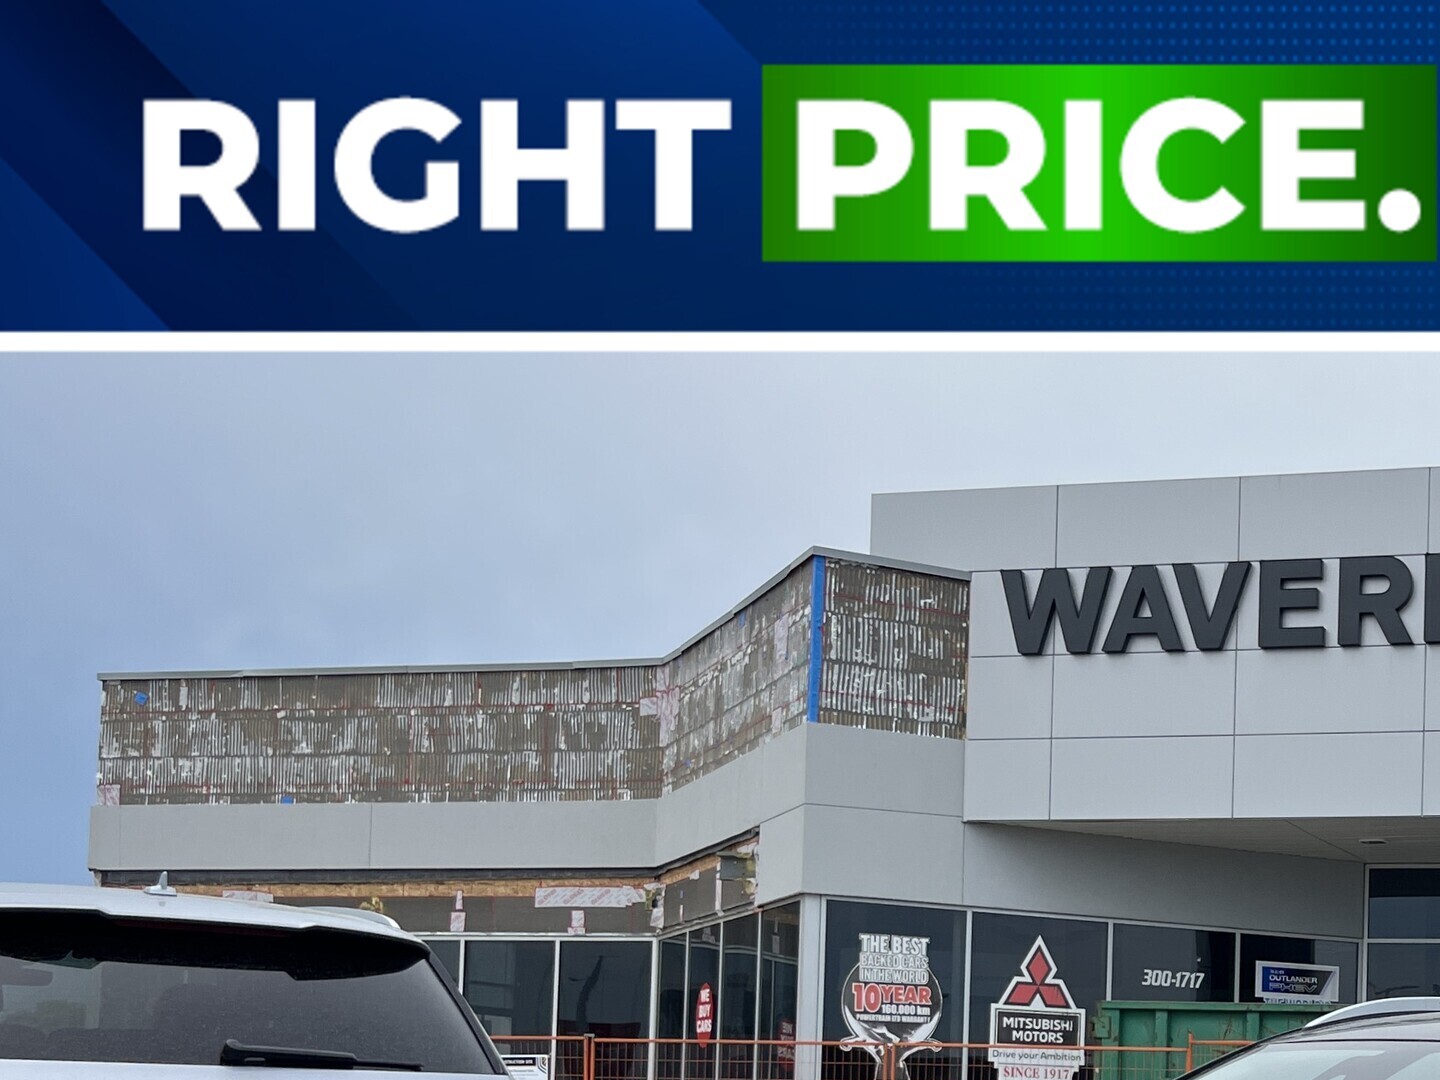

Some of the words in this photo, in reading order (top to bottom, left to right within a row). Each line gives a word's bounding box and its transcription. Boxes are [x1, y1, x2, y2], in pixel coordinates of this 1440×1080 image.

[860, 934, 889, 954] THE
[891, 935, 929, 956] BEST
[861, 954, 899, 968] BACKED
[901, 955, 928, 969] CARS
[861, 968, 872, 982] IN
[872, 968, 892, 982] THE
[893, 969, 928, 984] WORLD
[1142, 969, 1204, 988] 300-1717
[1269, 975, 1318, 984] OUTLANDER
[1269, 982, 1318, 993] PHEV
[852, 983, 881, 1013] 10
[881, 985, 931, 1005] YEAR
[917, 1005, 930, 1015] km
[1003, 1017, 1073, 1031] MITSUBISHI
[1012, 1030, 1063, 1043] MOTORS
[992, 1050, 1016, 1058] Drive
[1040, 1052, 1081, 1061] Ambition
[1003, 1066, 1039, 1078] SINCE
[1044, 1069, 1069, 1079] 1917
